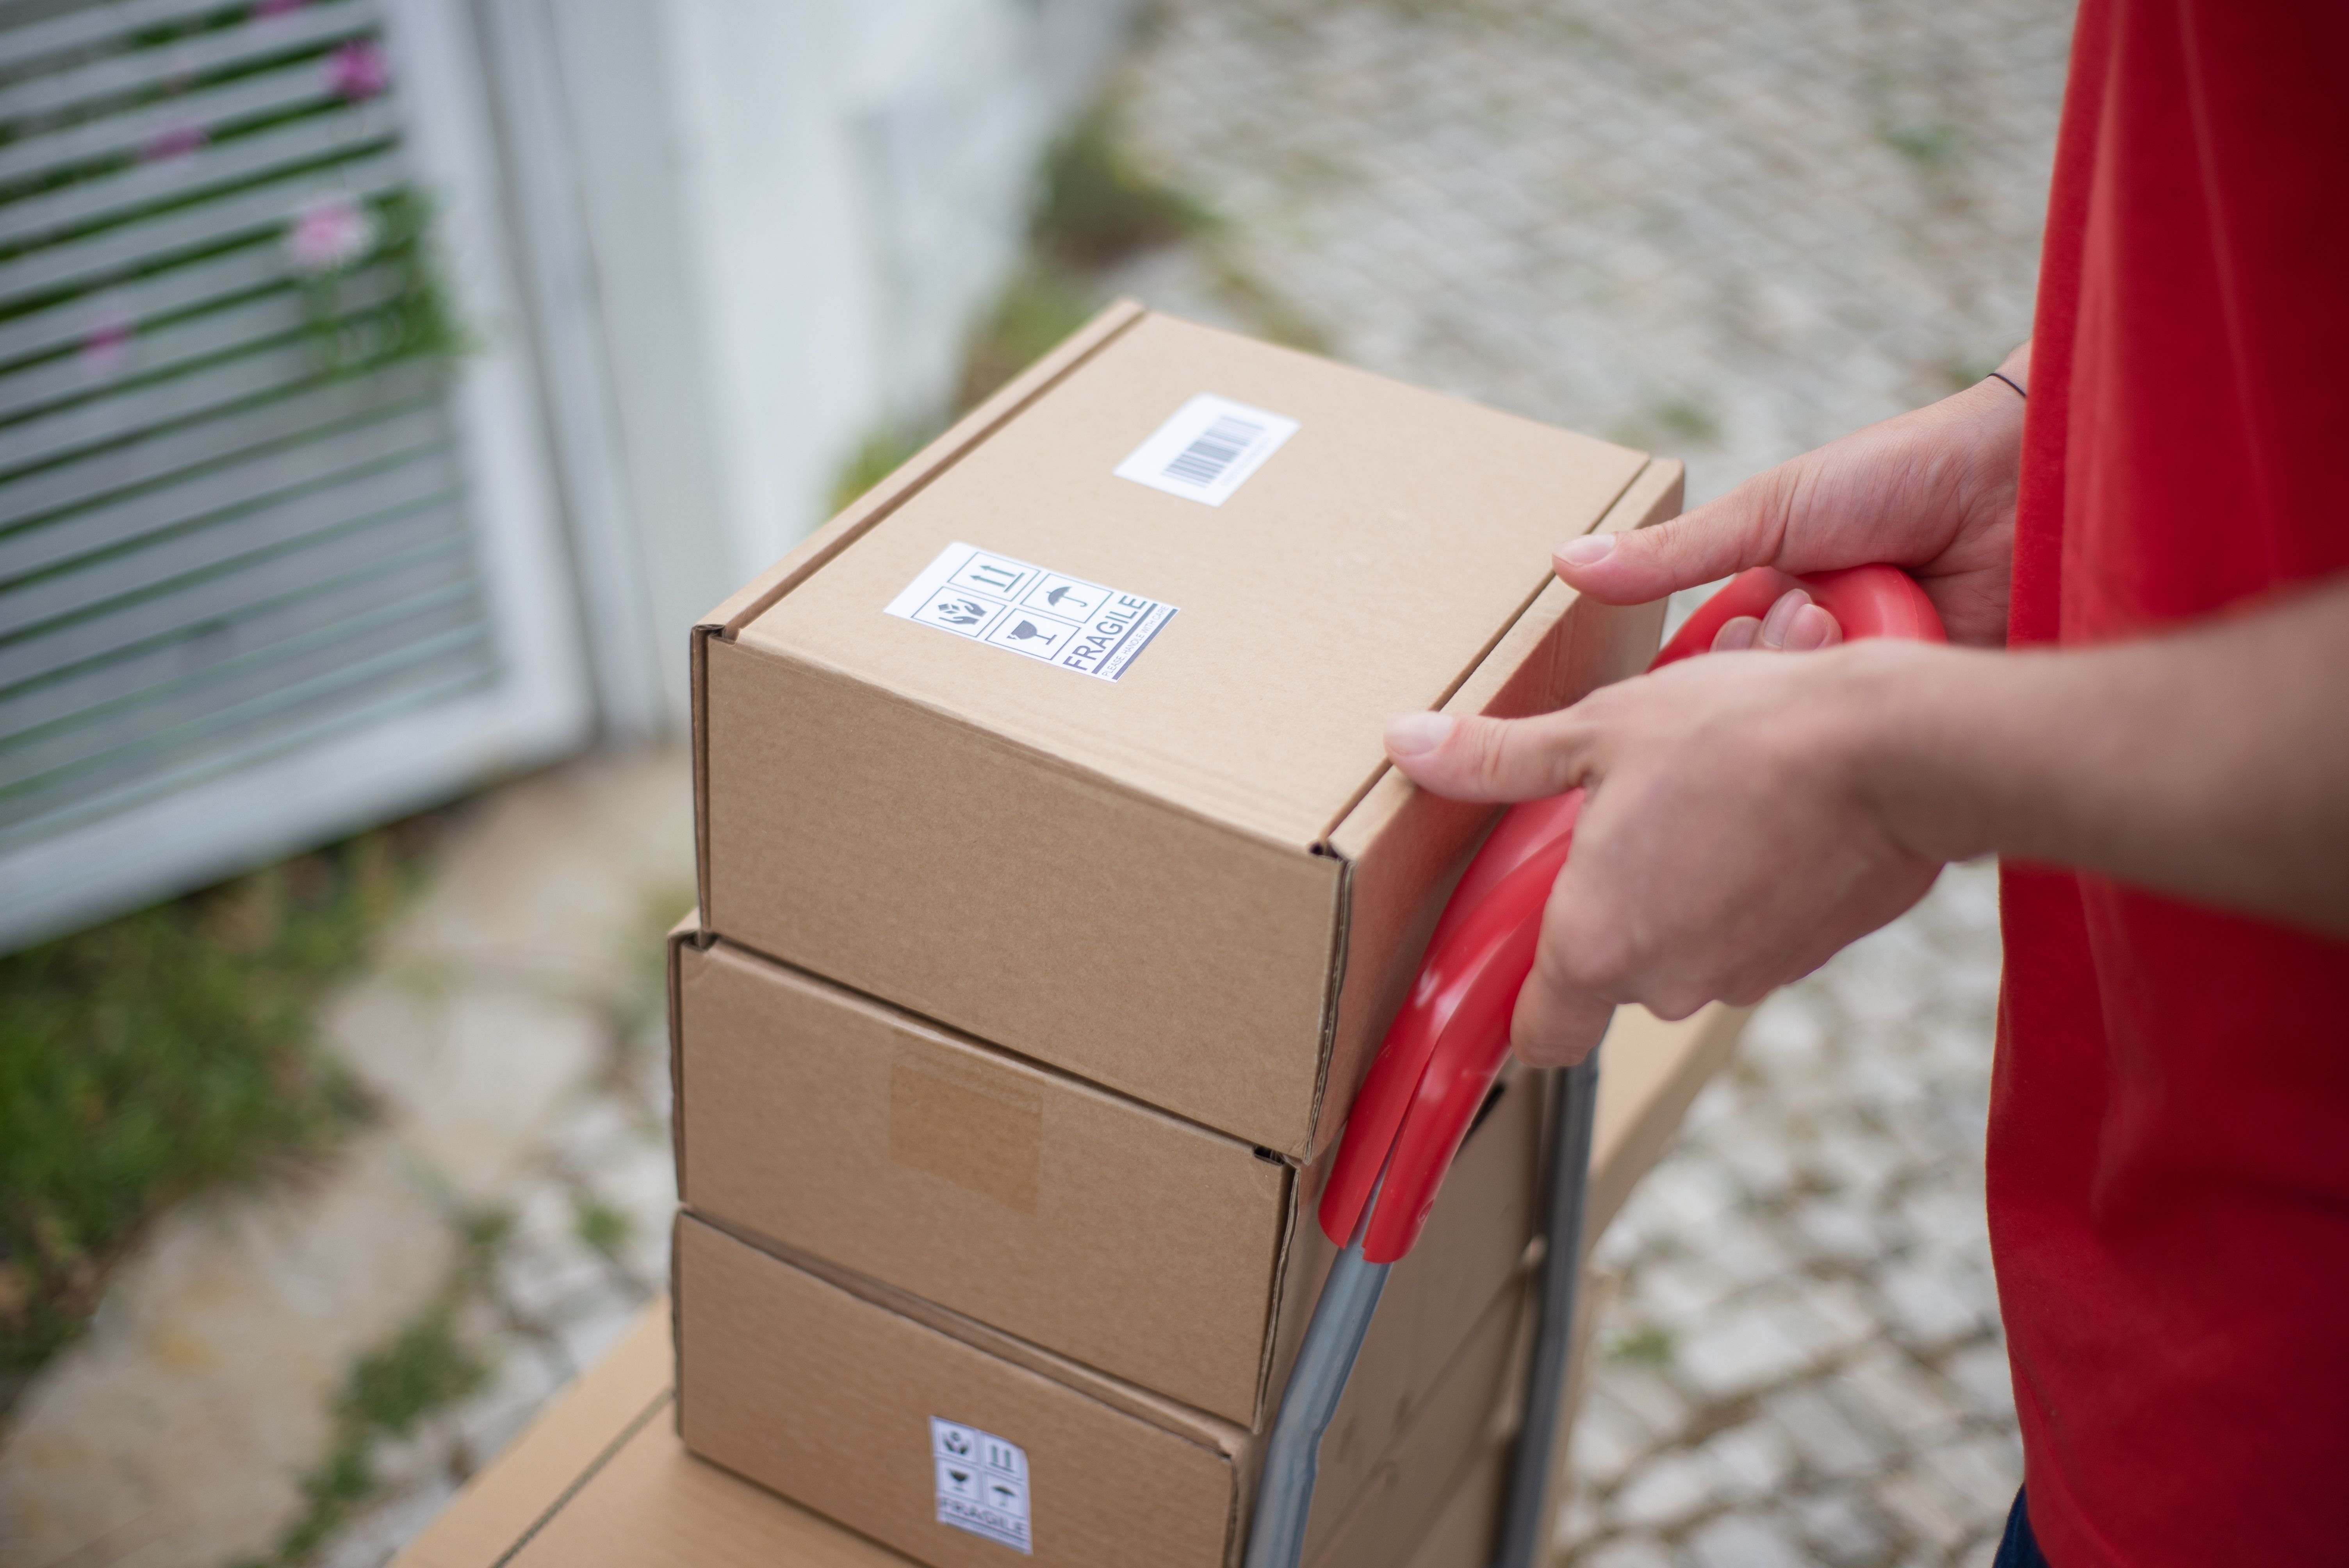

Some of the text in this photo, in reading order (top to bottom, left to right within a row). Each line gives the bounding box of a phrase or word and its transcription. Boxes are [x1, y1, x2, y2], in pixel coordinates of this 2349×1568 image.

[1062, 595, 1148, 671] FRAGILE
[1102, 606, 1169, 677] PLEASE, HANDLE WITH CARE
[940, 1497, 1027, 1537] FRAGILE
